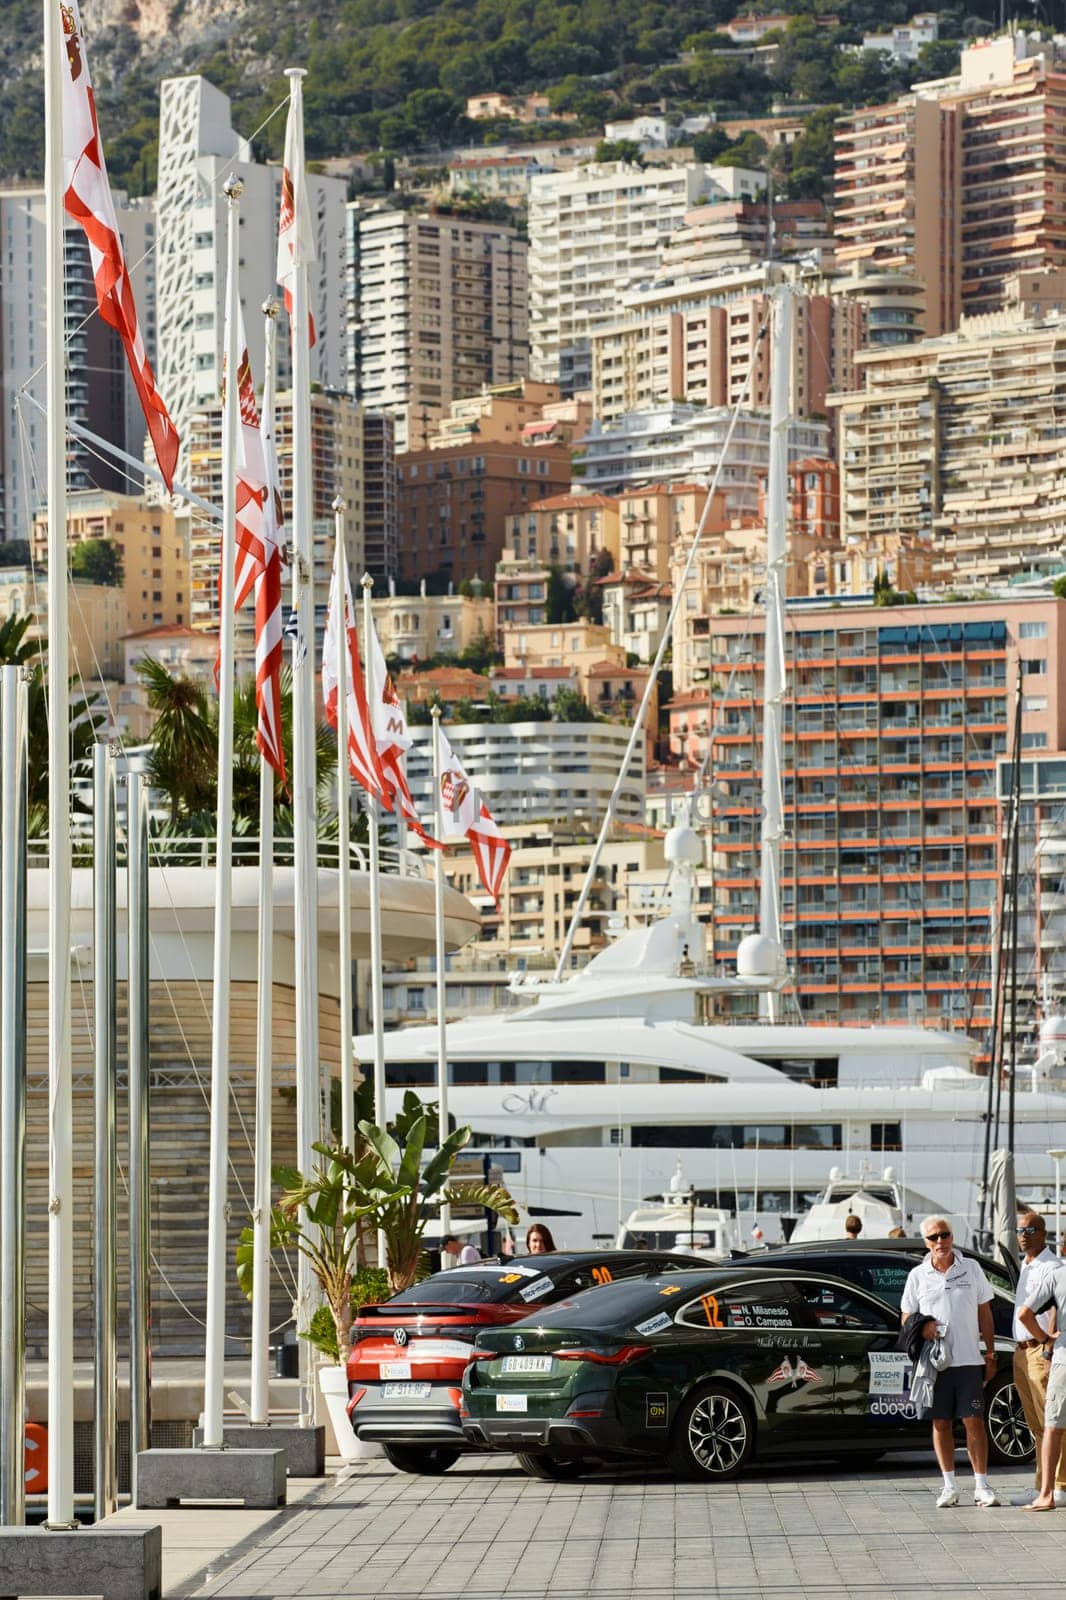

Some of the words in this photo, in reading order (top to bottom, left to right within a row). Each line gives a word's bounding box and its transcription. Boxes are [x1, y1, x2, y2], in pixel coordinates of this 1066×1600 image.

[701, 1294, 723, 1327] 12
[741, 1305, 751, 1314] N.
[752, 1305, 789, 1315] Milanesio
[756, 1316, 792, 1328] Campana
